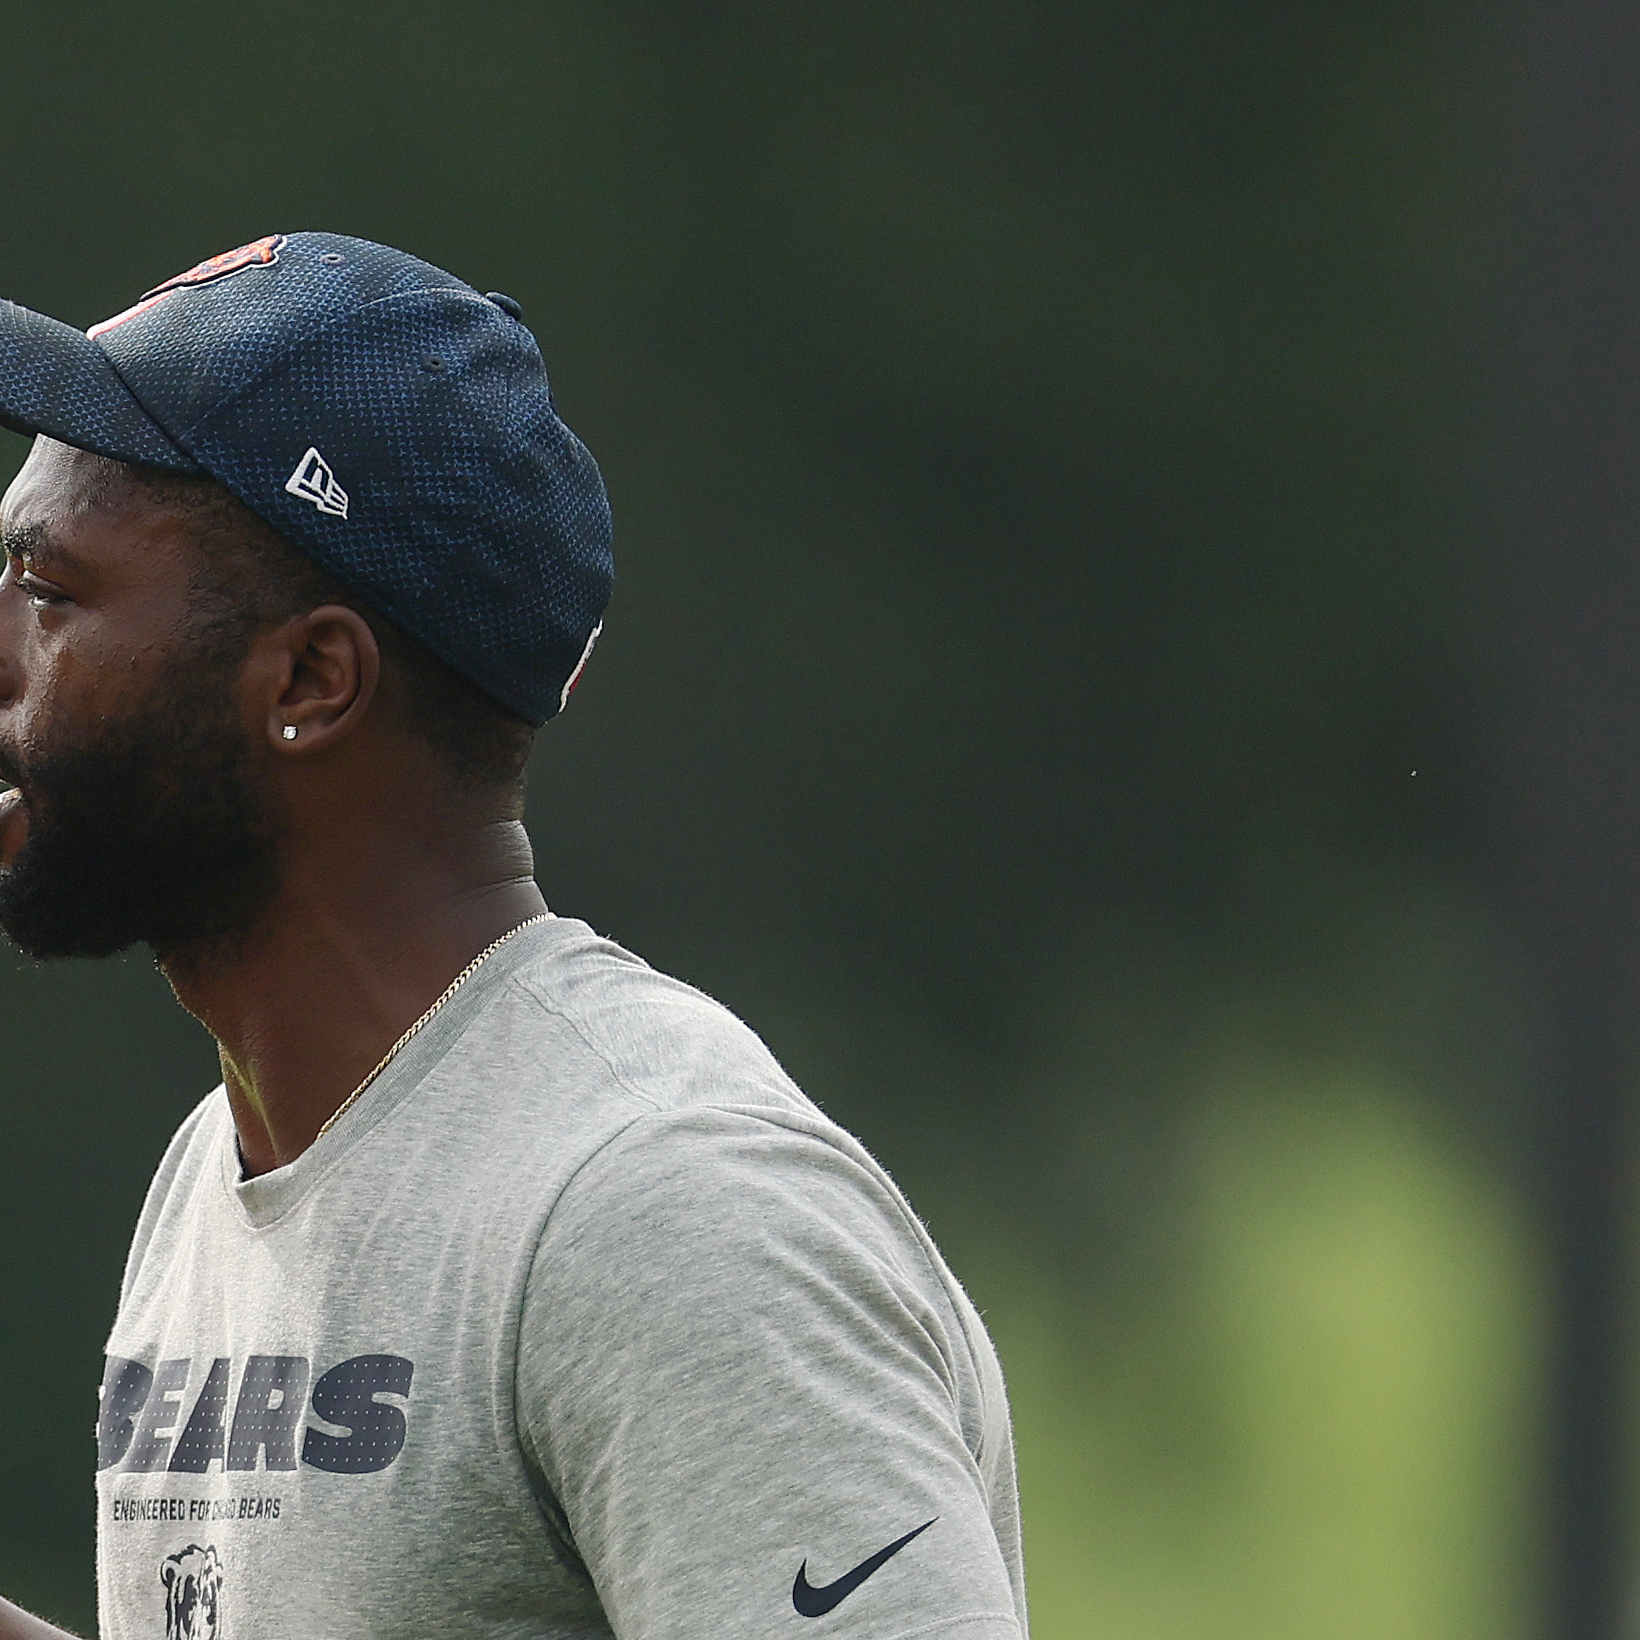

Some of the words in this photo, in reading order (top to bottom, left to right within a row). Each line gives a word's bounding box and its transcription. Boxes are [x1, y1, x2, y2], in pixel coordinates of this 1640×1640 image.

[96, 1354, 414, 1474] BEARS
[113, 1498, 186, 1521] ENGINEERED
[238, 1498, 281, 1520] BEARS
